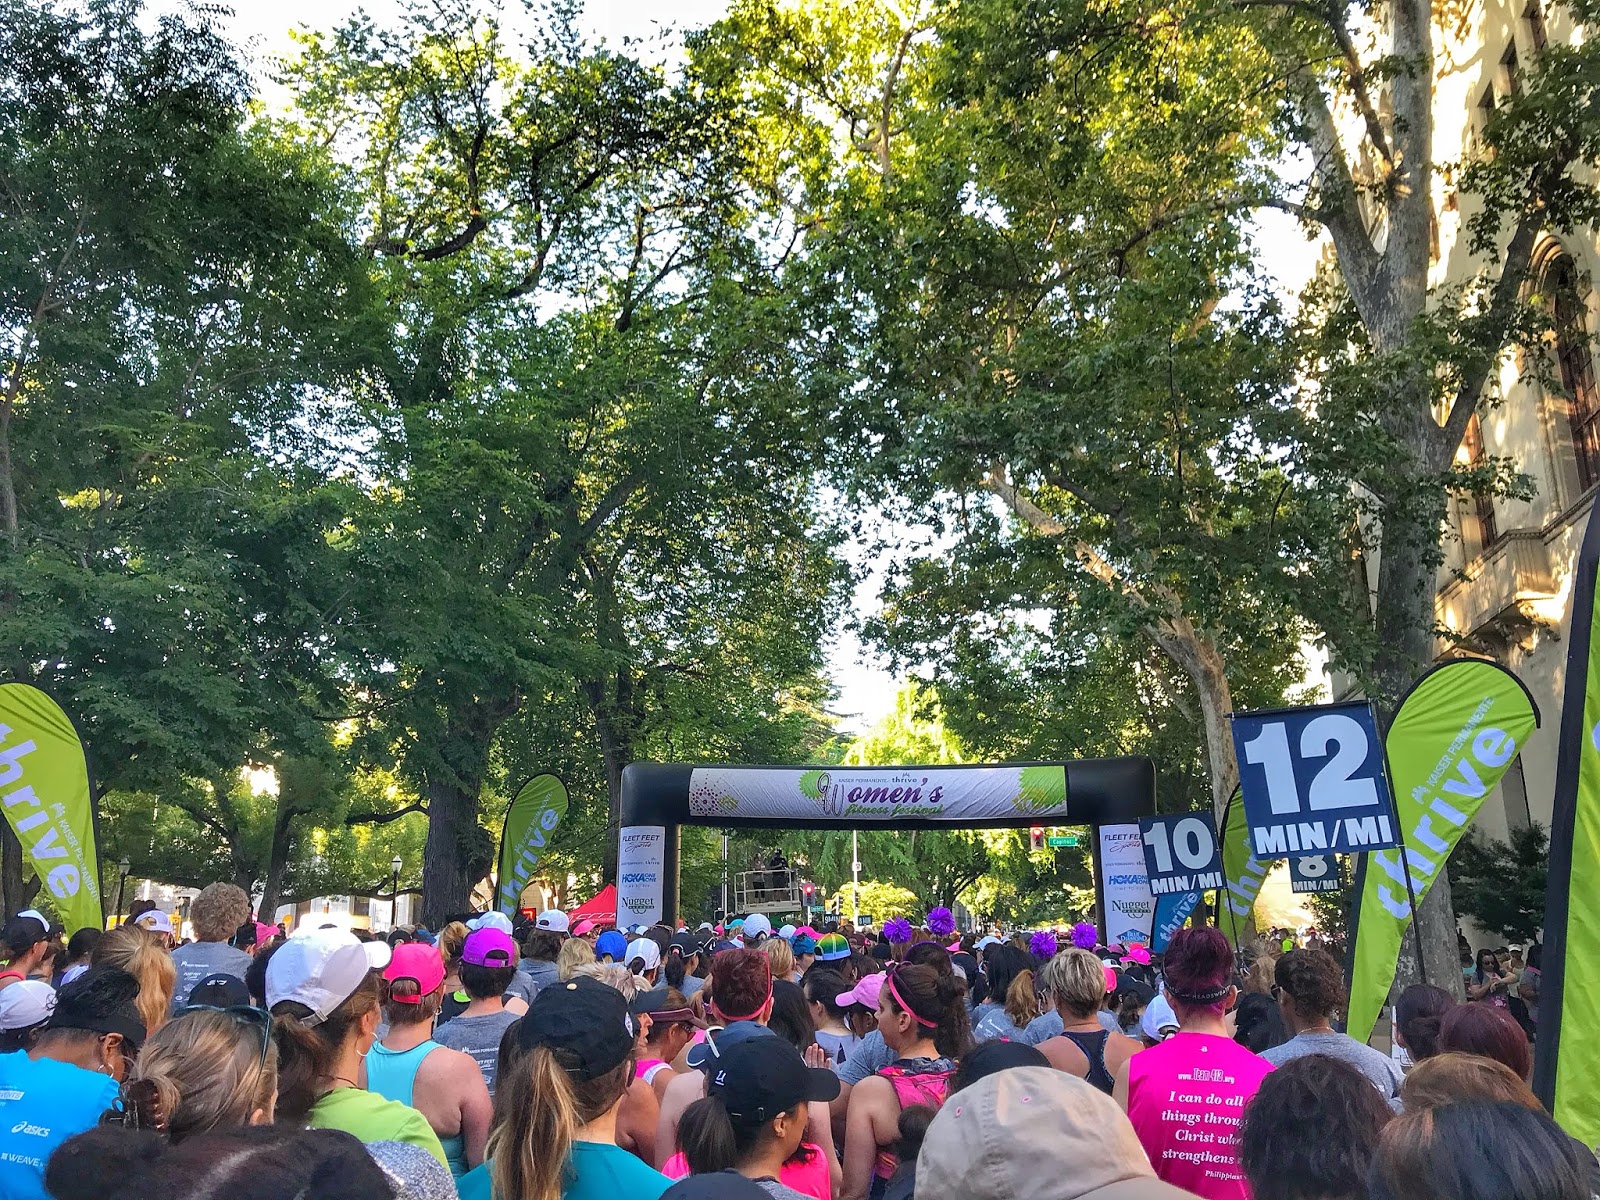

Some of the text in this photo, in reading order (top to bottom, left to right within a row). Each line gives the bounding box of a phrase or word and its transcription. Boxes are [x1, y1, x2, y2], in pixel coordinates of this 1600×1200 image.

[1426, 696, 1495, 787] KAISER PERMANENTE
[1244, 714, 1379, 815] 12
[817, 772, 944, 816] Women's
[0, 722, 81, 899] hrive
[1374, 727, 1516, 920] thrive
[1104, 833, 1128, 841] FLEET
[1253, 815, 1393, 855] MIN/MI
[1143, 817, 1214, 873] 10
[1297, 855, 1328, 878] 8
[621, 873, 645, 883] HOKA
[1108, 874, 1139, 885] HOKA
[1150, 871, 1223, 895] MIN/MI
[1292, 879, 1339, 892] MIN/MI
[621, 896, 654, 908] Nugget
[1111, 900, 1150, 912] Nugget
[1160, 892, 1198, 942] thrive
[1168, 1091, 1244, 1107] I can do all
[1161, 1109, 1202, 1126] things
[1175, 1129, 1214, 1143] Christ
[9, 1153, 41, 1167] WEAVE
[1162, 1148, 1235, 1165] strengthens
